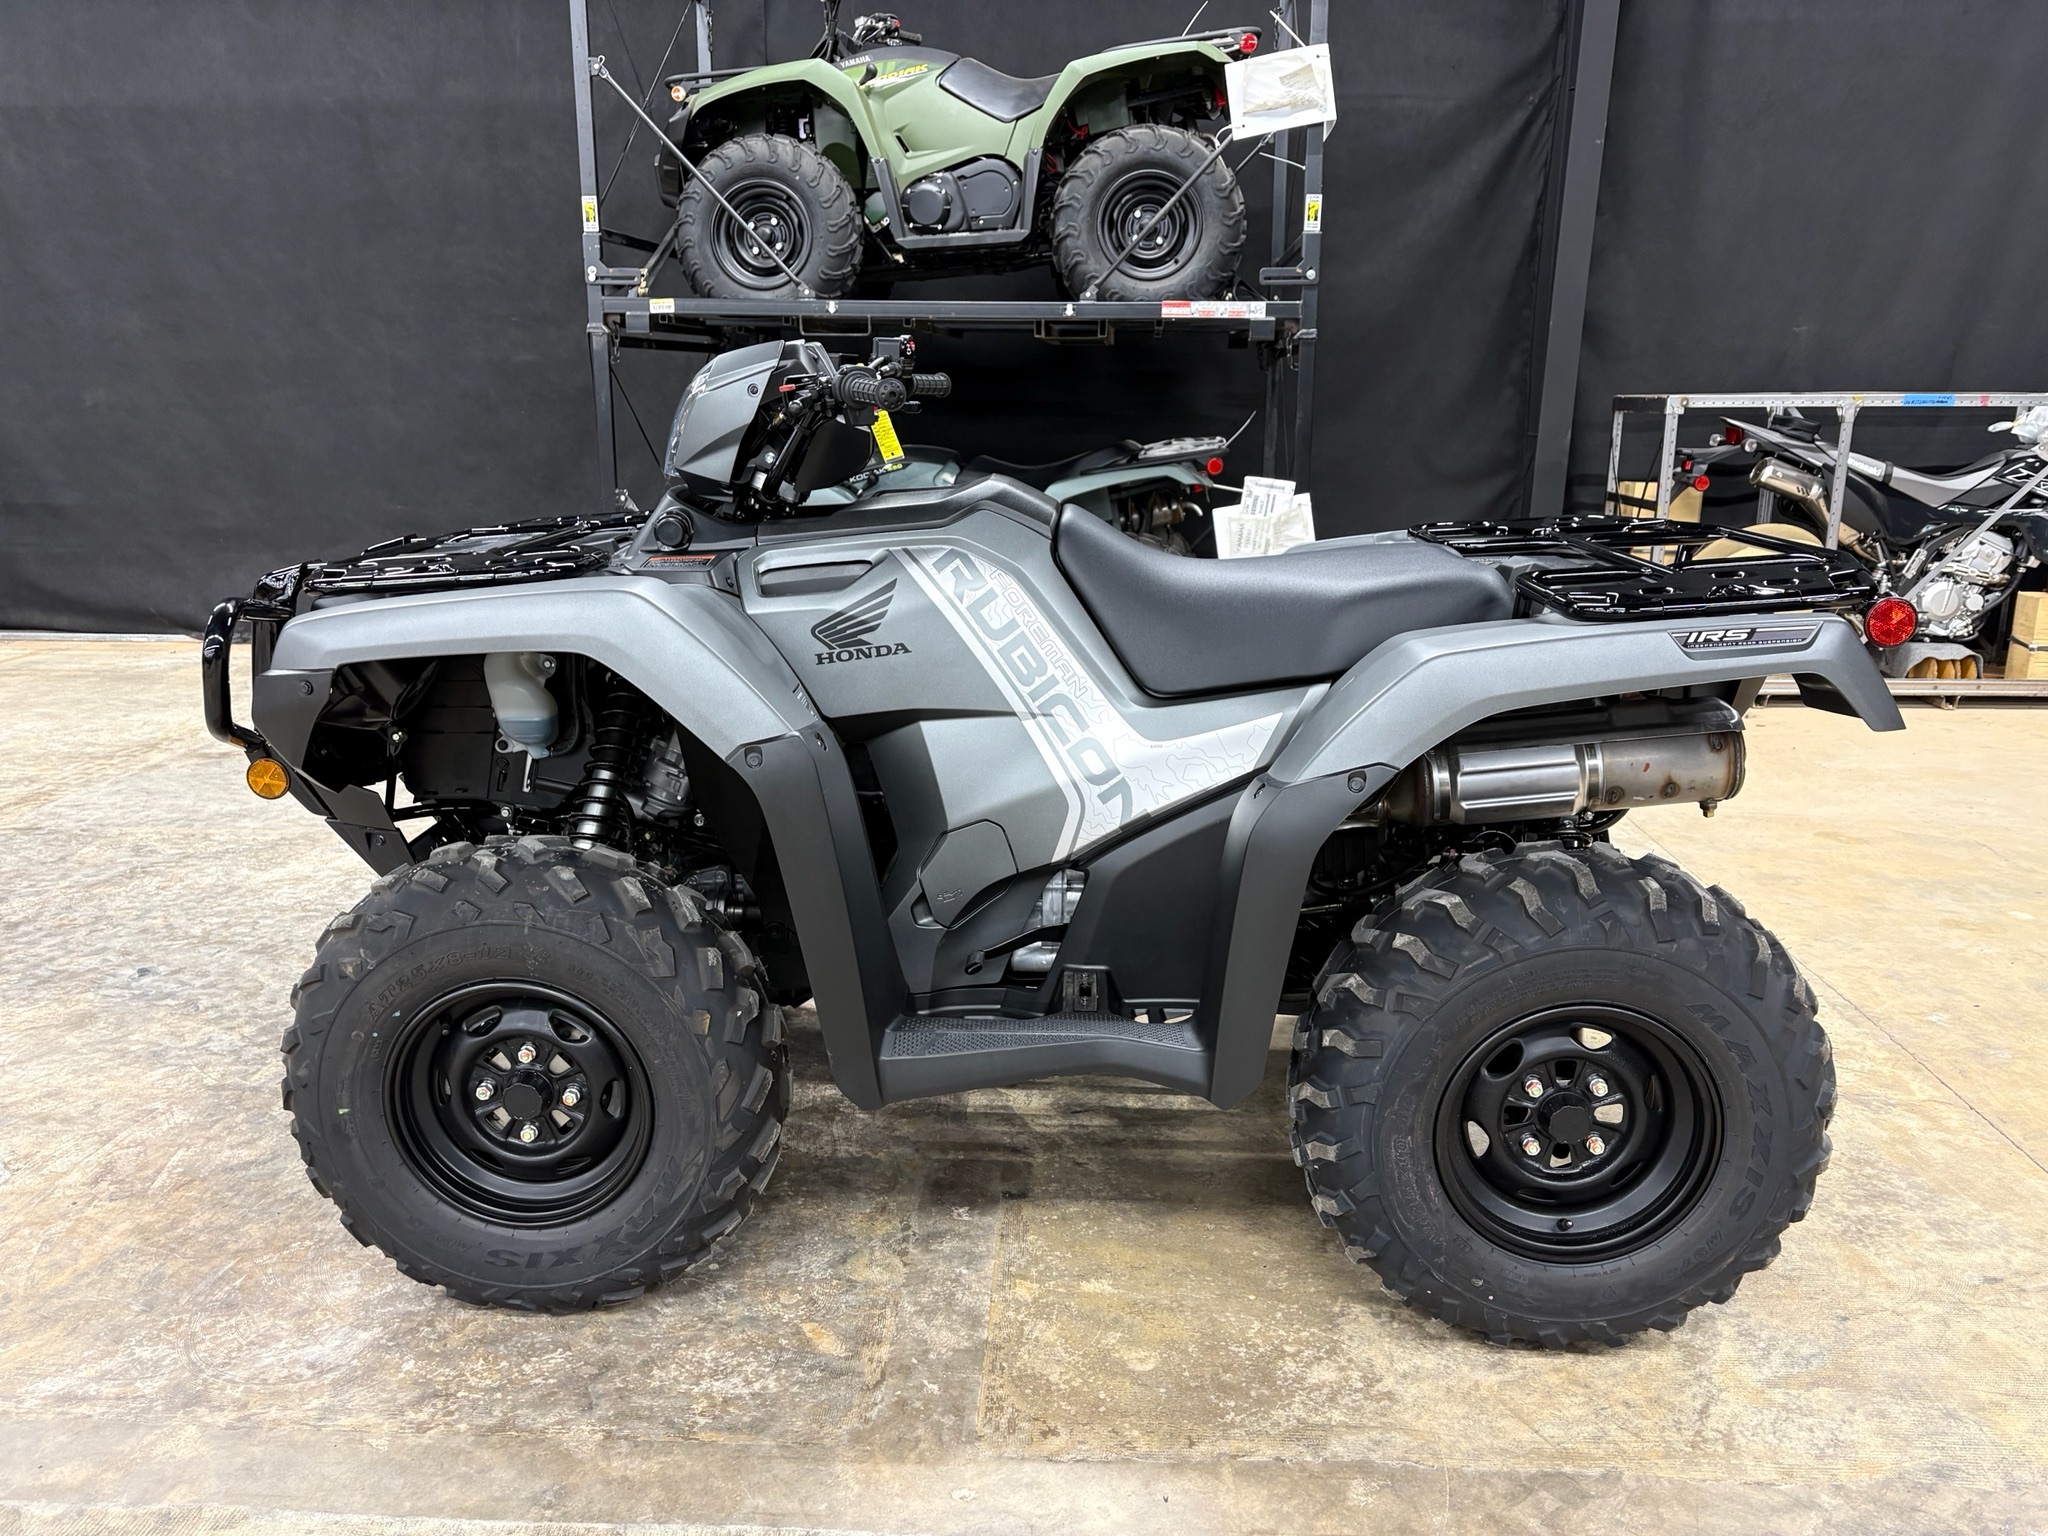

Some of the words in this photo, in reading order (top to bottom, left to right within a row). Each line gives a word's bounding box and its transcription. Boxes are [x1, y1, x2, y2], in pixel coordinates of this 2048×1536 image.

[840, 55, 871, 68] YAMAHA
[849, 466, 886, 483] KODAK
[1847, 457, 1882, 477] awasaki
[989, 569, 1088, 699] FOREMAN
[1687, 629, 1751, 643] IRS
[1687, 641, 1736, 649] INDEPENDENT
[1758, 637, 1803, 645] SUSPENSION
[815, 642, 912, 666] HONDA
[1686, 1003, 1773, 1221] MAXXIS
[484, 1154, 683, 1270] MAXXIS
